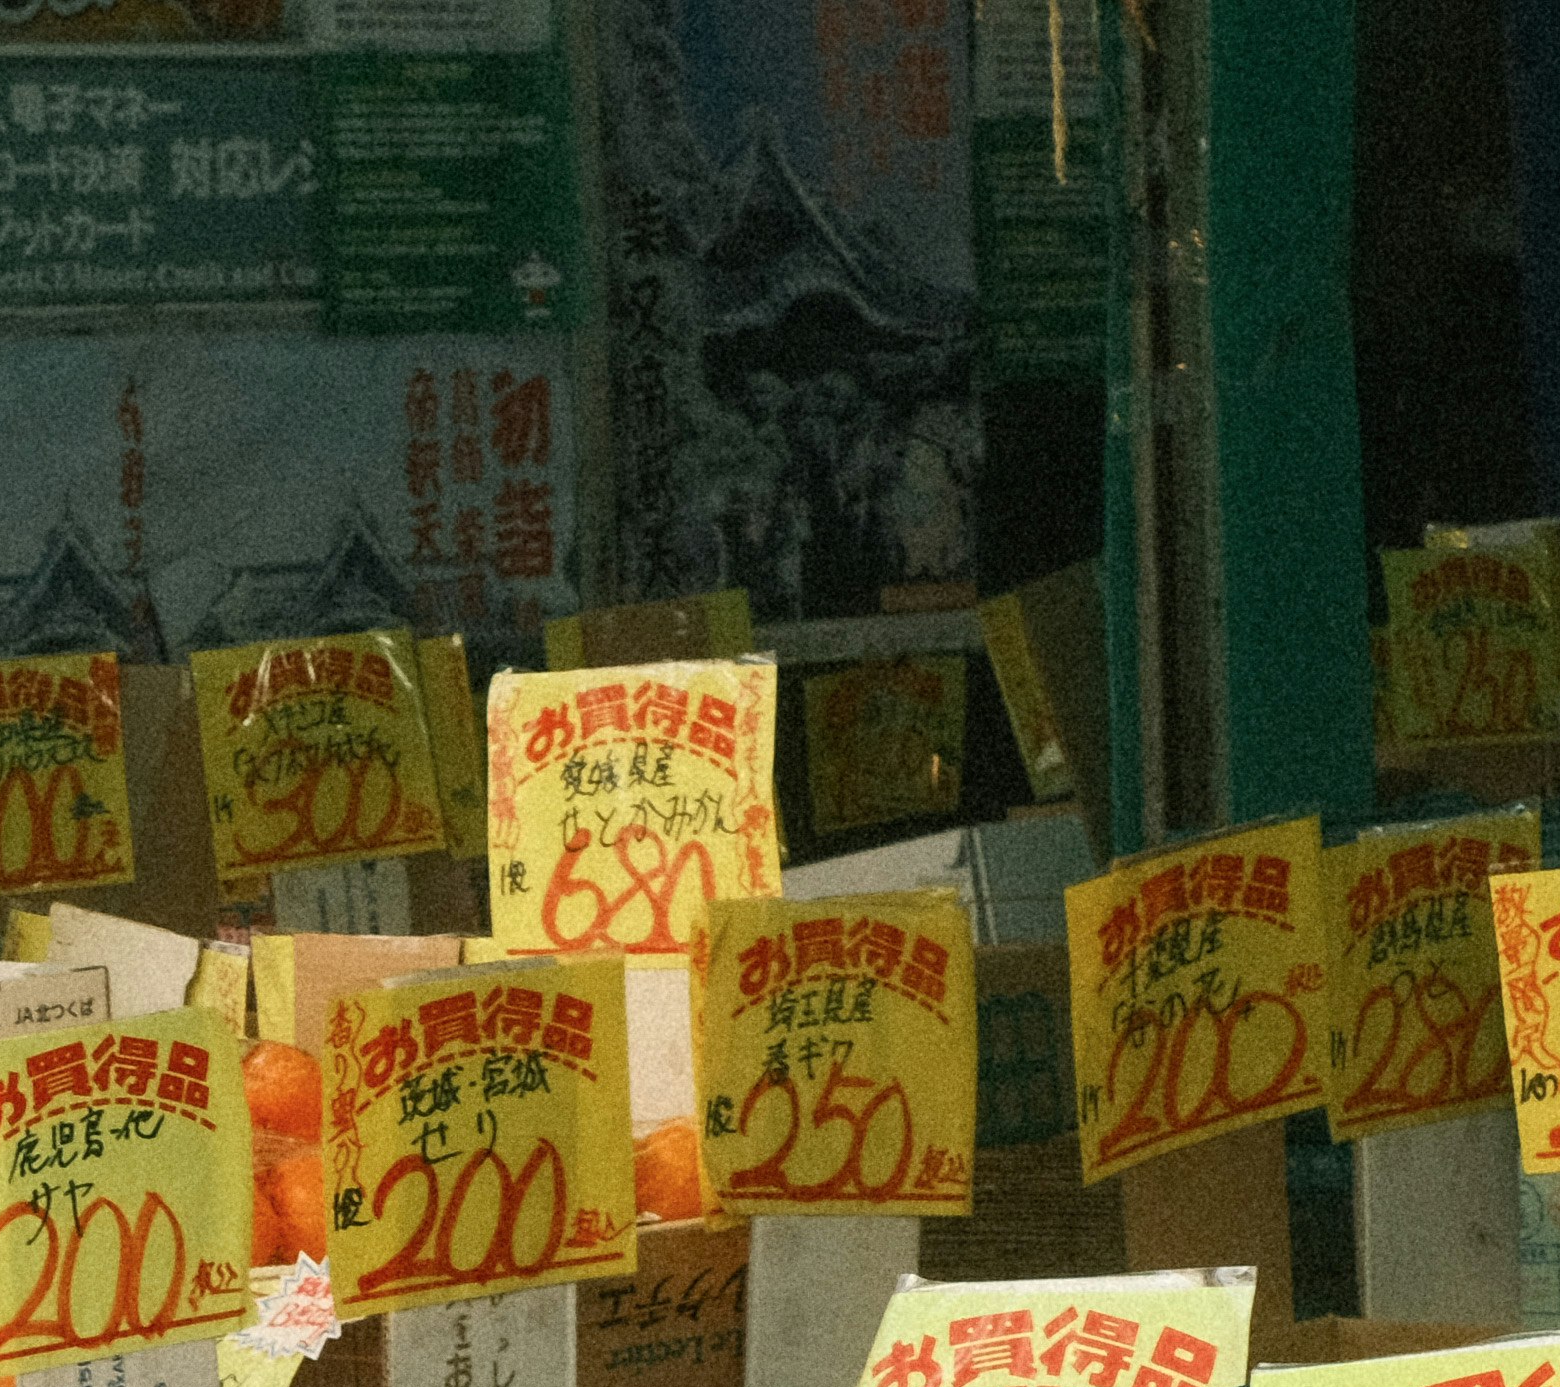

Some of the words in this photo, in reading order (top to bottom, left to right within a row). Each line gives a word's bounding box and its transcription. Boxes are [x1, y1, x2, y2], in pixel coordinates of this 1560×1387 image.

[522, 680, 738, 763] お買得品
[233, 738, 401, 862] 300
[737, 916, 951, 1004] お買得品
[1097, 853, 1292, 967] お買得品
[15, 1001, 94, 1025] JA北つくば
[359, 985, 594, 1089] お買得品
[765, 974, 879, 1034] 埼玉県産
[1099, 990, 1308, 1164] 200
[728, 1059, 914, 1203] 250
[26, 1179, 94, 1246] サヤ
[357, 1137, 568, 1294] 200
